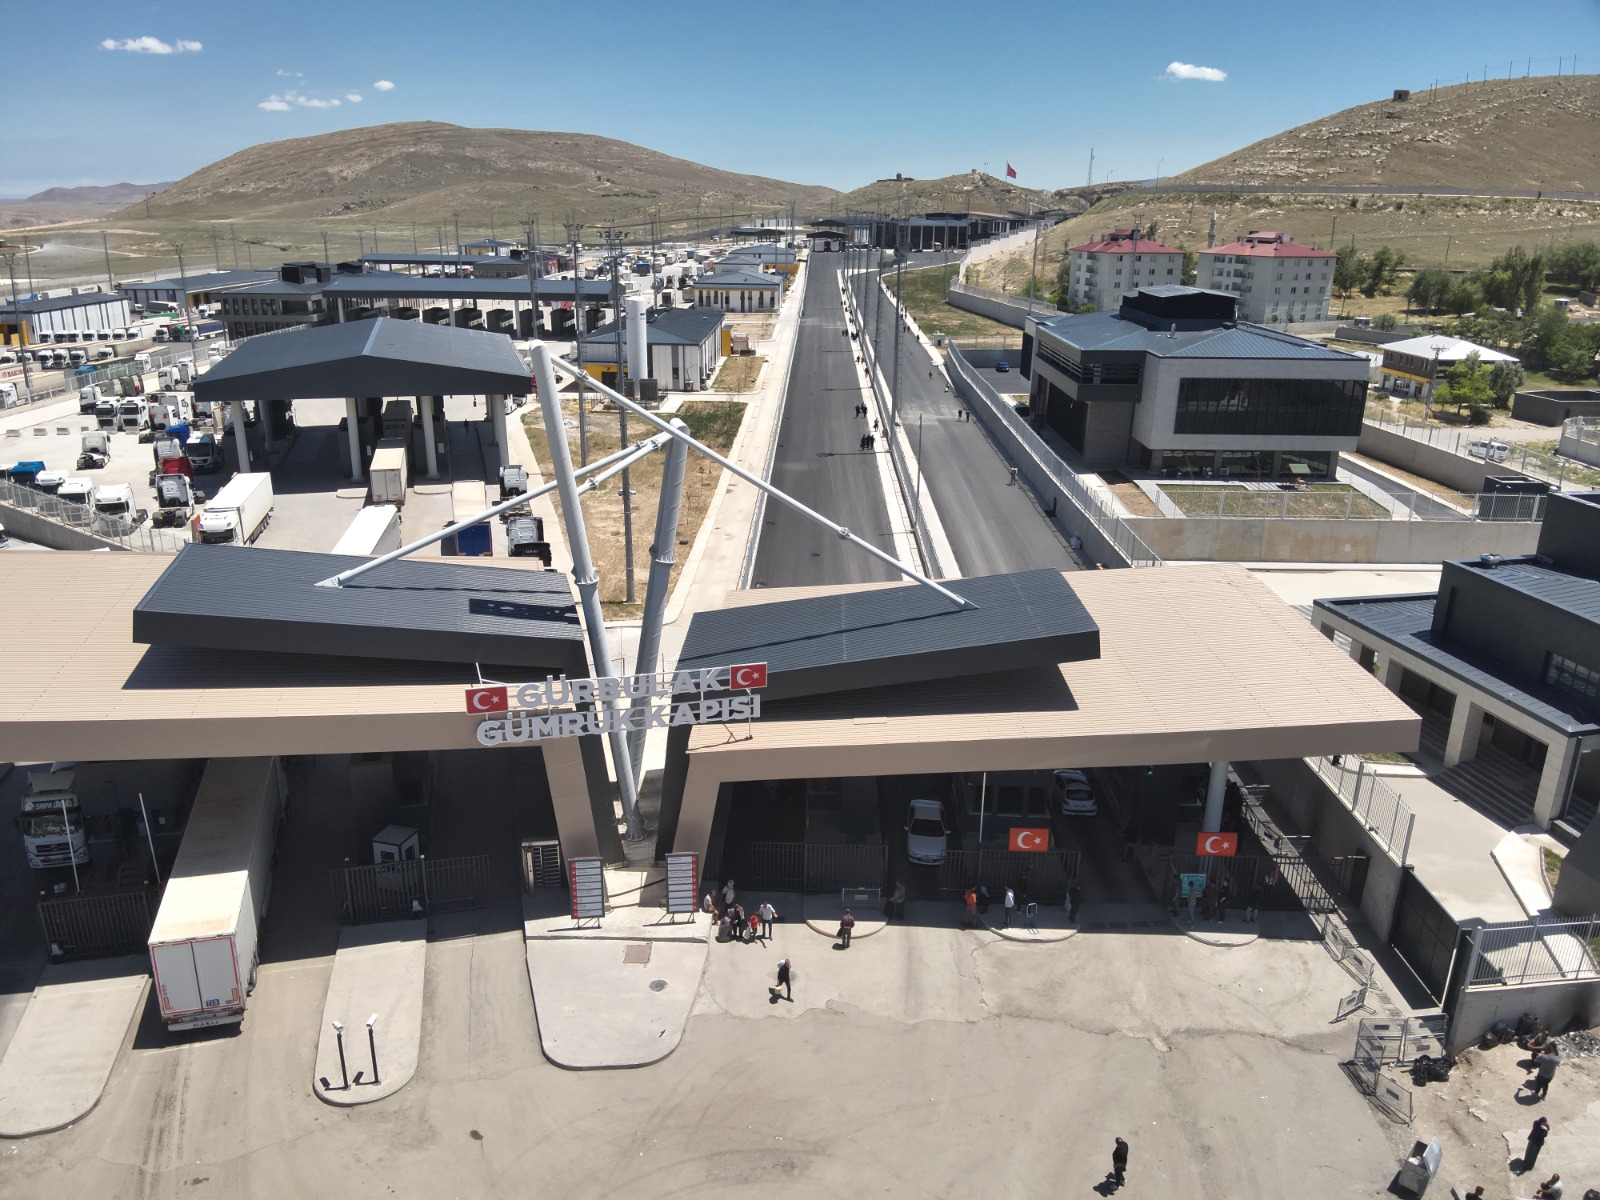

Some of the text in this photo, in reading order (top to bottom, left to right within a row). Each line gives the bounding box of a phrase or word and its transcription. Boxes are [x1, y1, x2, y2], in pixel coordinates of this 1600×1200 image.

[517, 669, 722, 708] GÜRBULAK
[476, 694, 761, 746] GÜMRÜK KAPISI
